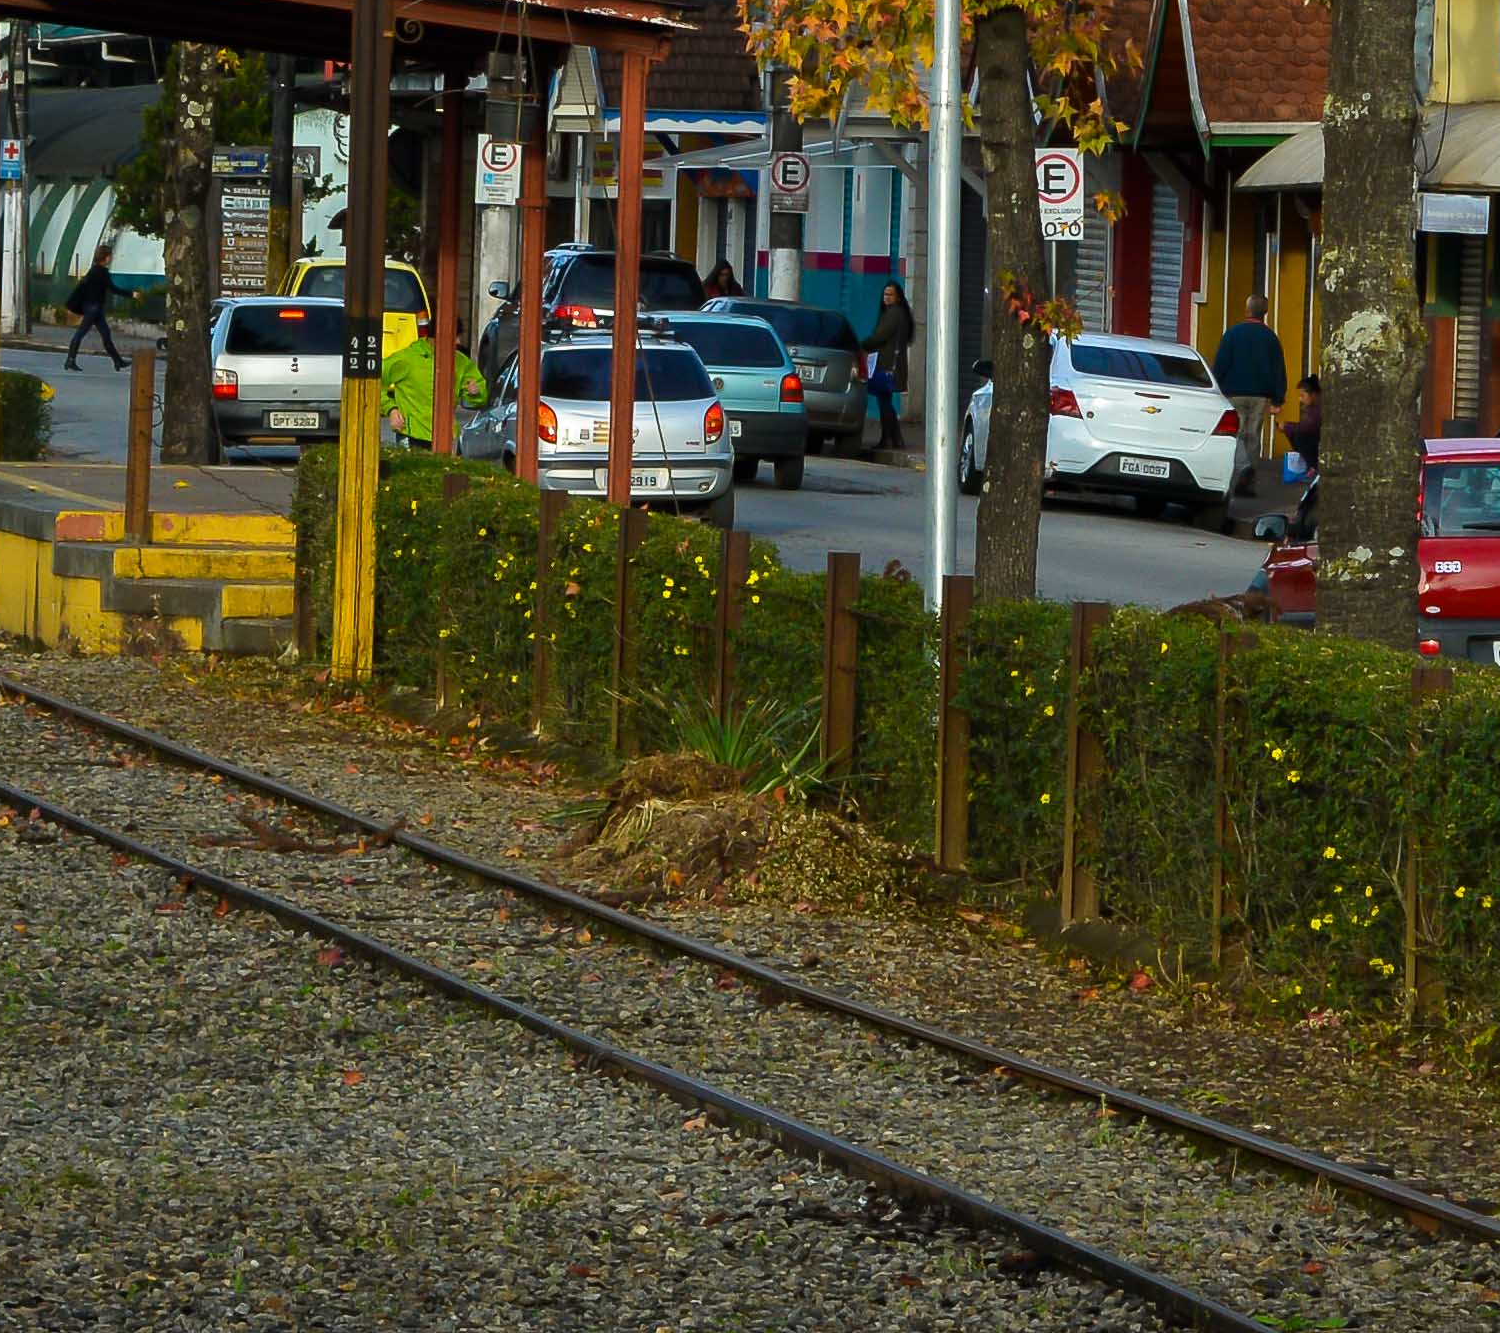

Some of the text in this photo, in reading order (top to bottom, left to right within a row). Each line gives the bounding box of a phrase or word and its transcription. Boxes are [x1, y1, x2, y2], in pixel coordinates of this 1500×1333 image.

[490, 144, 507, 165] E
[782, 160, 801, 185] E
[1043, 163, 1067, 194] E
[1044, 221, 1082, 238] OTO
